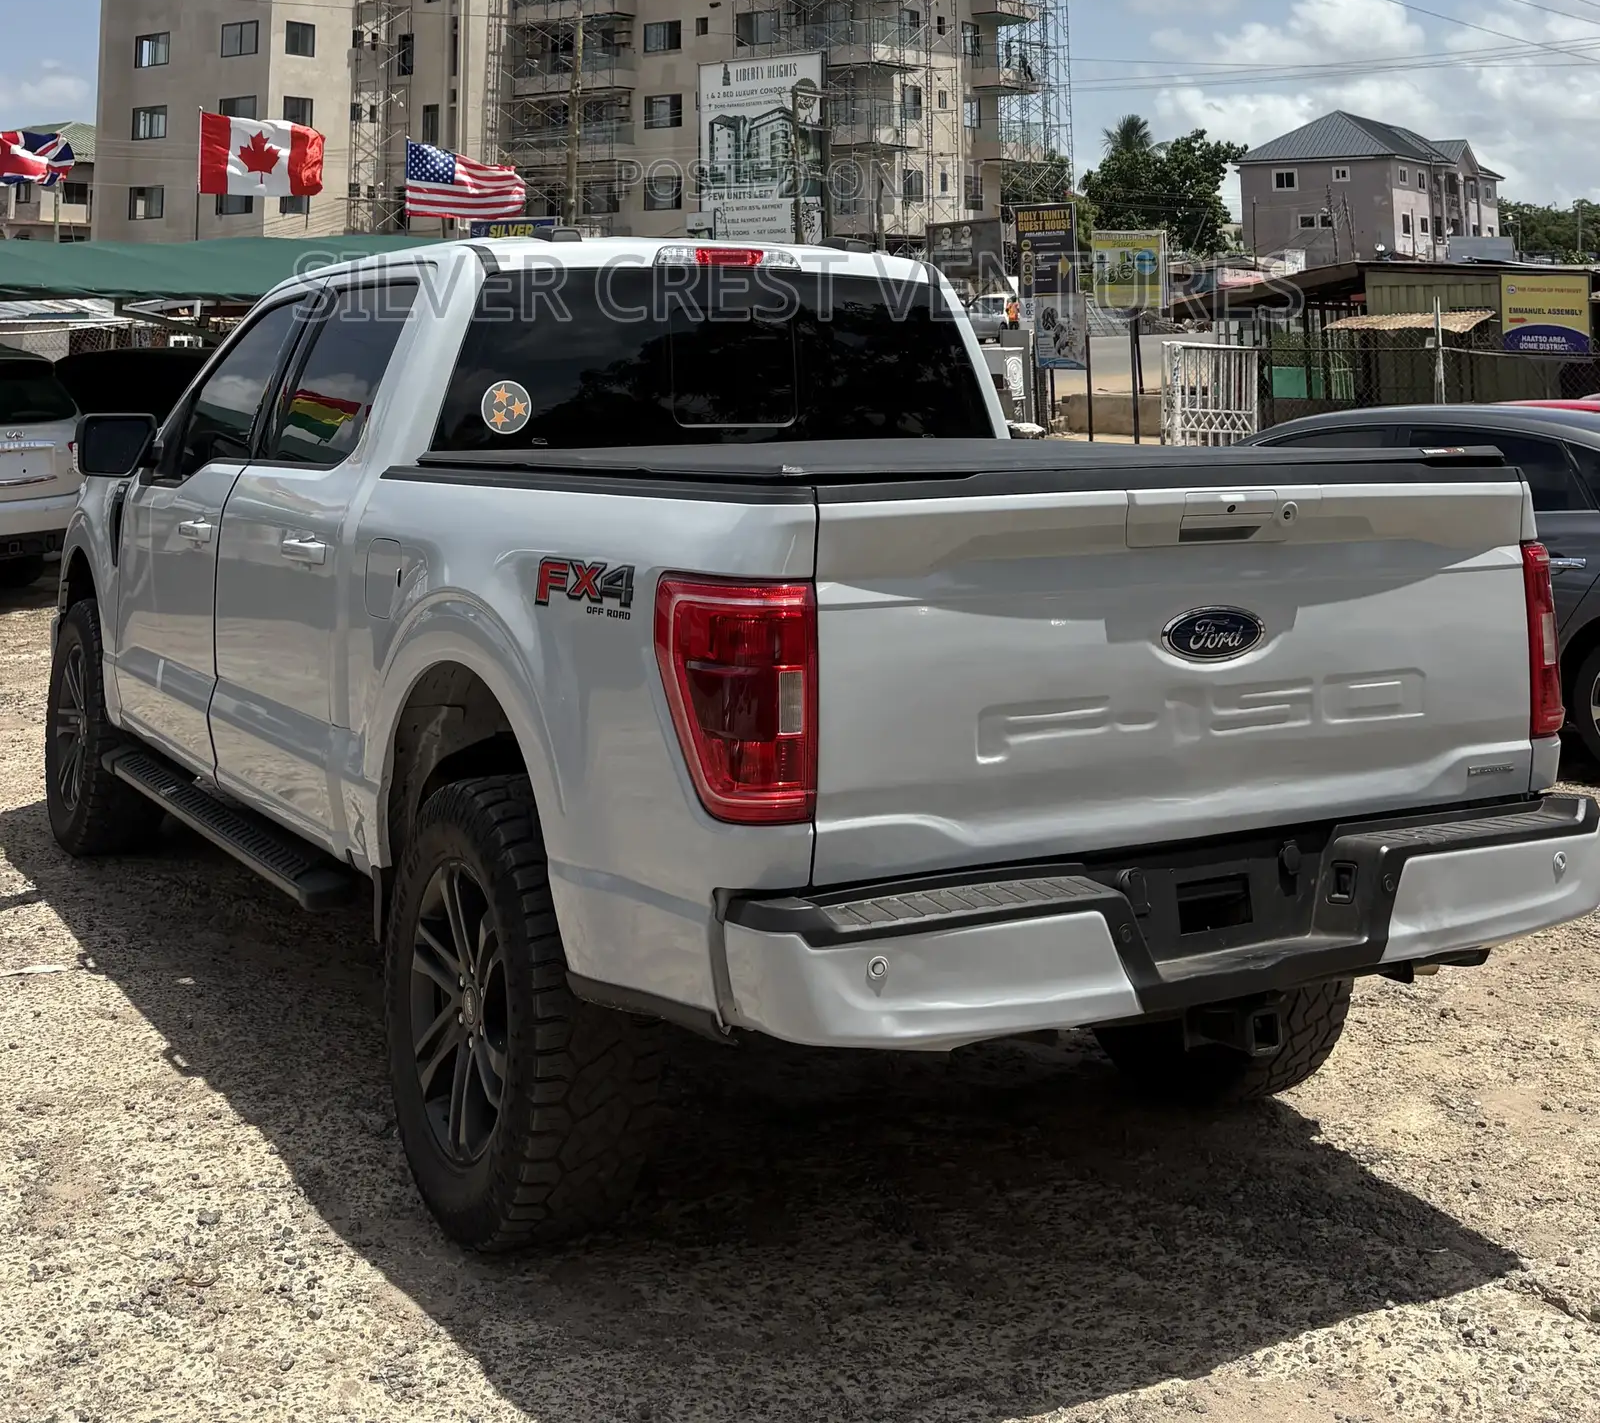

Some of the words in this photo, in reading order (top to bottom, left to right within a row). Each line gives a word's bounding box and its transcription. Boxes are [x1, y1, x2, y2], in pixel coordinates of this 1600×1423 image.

[735, 66, 764, 82] LIBERTY
[767, 63, 798, 79] HEIGHTS
[735, 89, 758, 97] LUXURY
[760, 86, 787, 95] CONDOS
[708, 192, 725, 201] FEW
[727, 190, 752, 200] UNITS
[753, 189, 774, 199] LEFT
[1017, 211, 1037, 222] HOLY
[1039, 209, 1070, 220] TRINITY
[1018, 220, 1044, 232] GUEST
[1044, 219, 1072, 231] HOUSE
[1508, 307, 1546, 315] EMMANUEL
[1547, 308, 1583, 316] ASSEMBLY
[1519, 342, 1539, 350] DOME
[1539, 343, 1569, 351] DISTRICT
[534, 555, 636, 609] FX4
[586, 605, 604, 616] OFF
[606, 608, 631, 621] ROAD
[1189, 618, 1244, 650] Ford
[975, 667, 1427, 765] F-150
